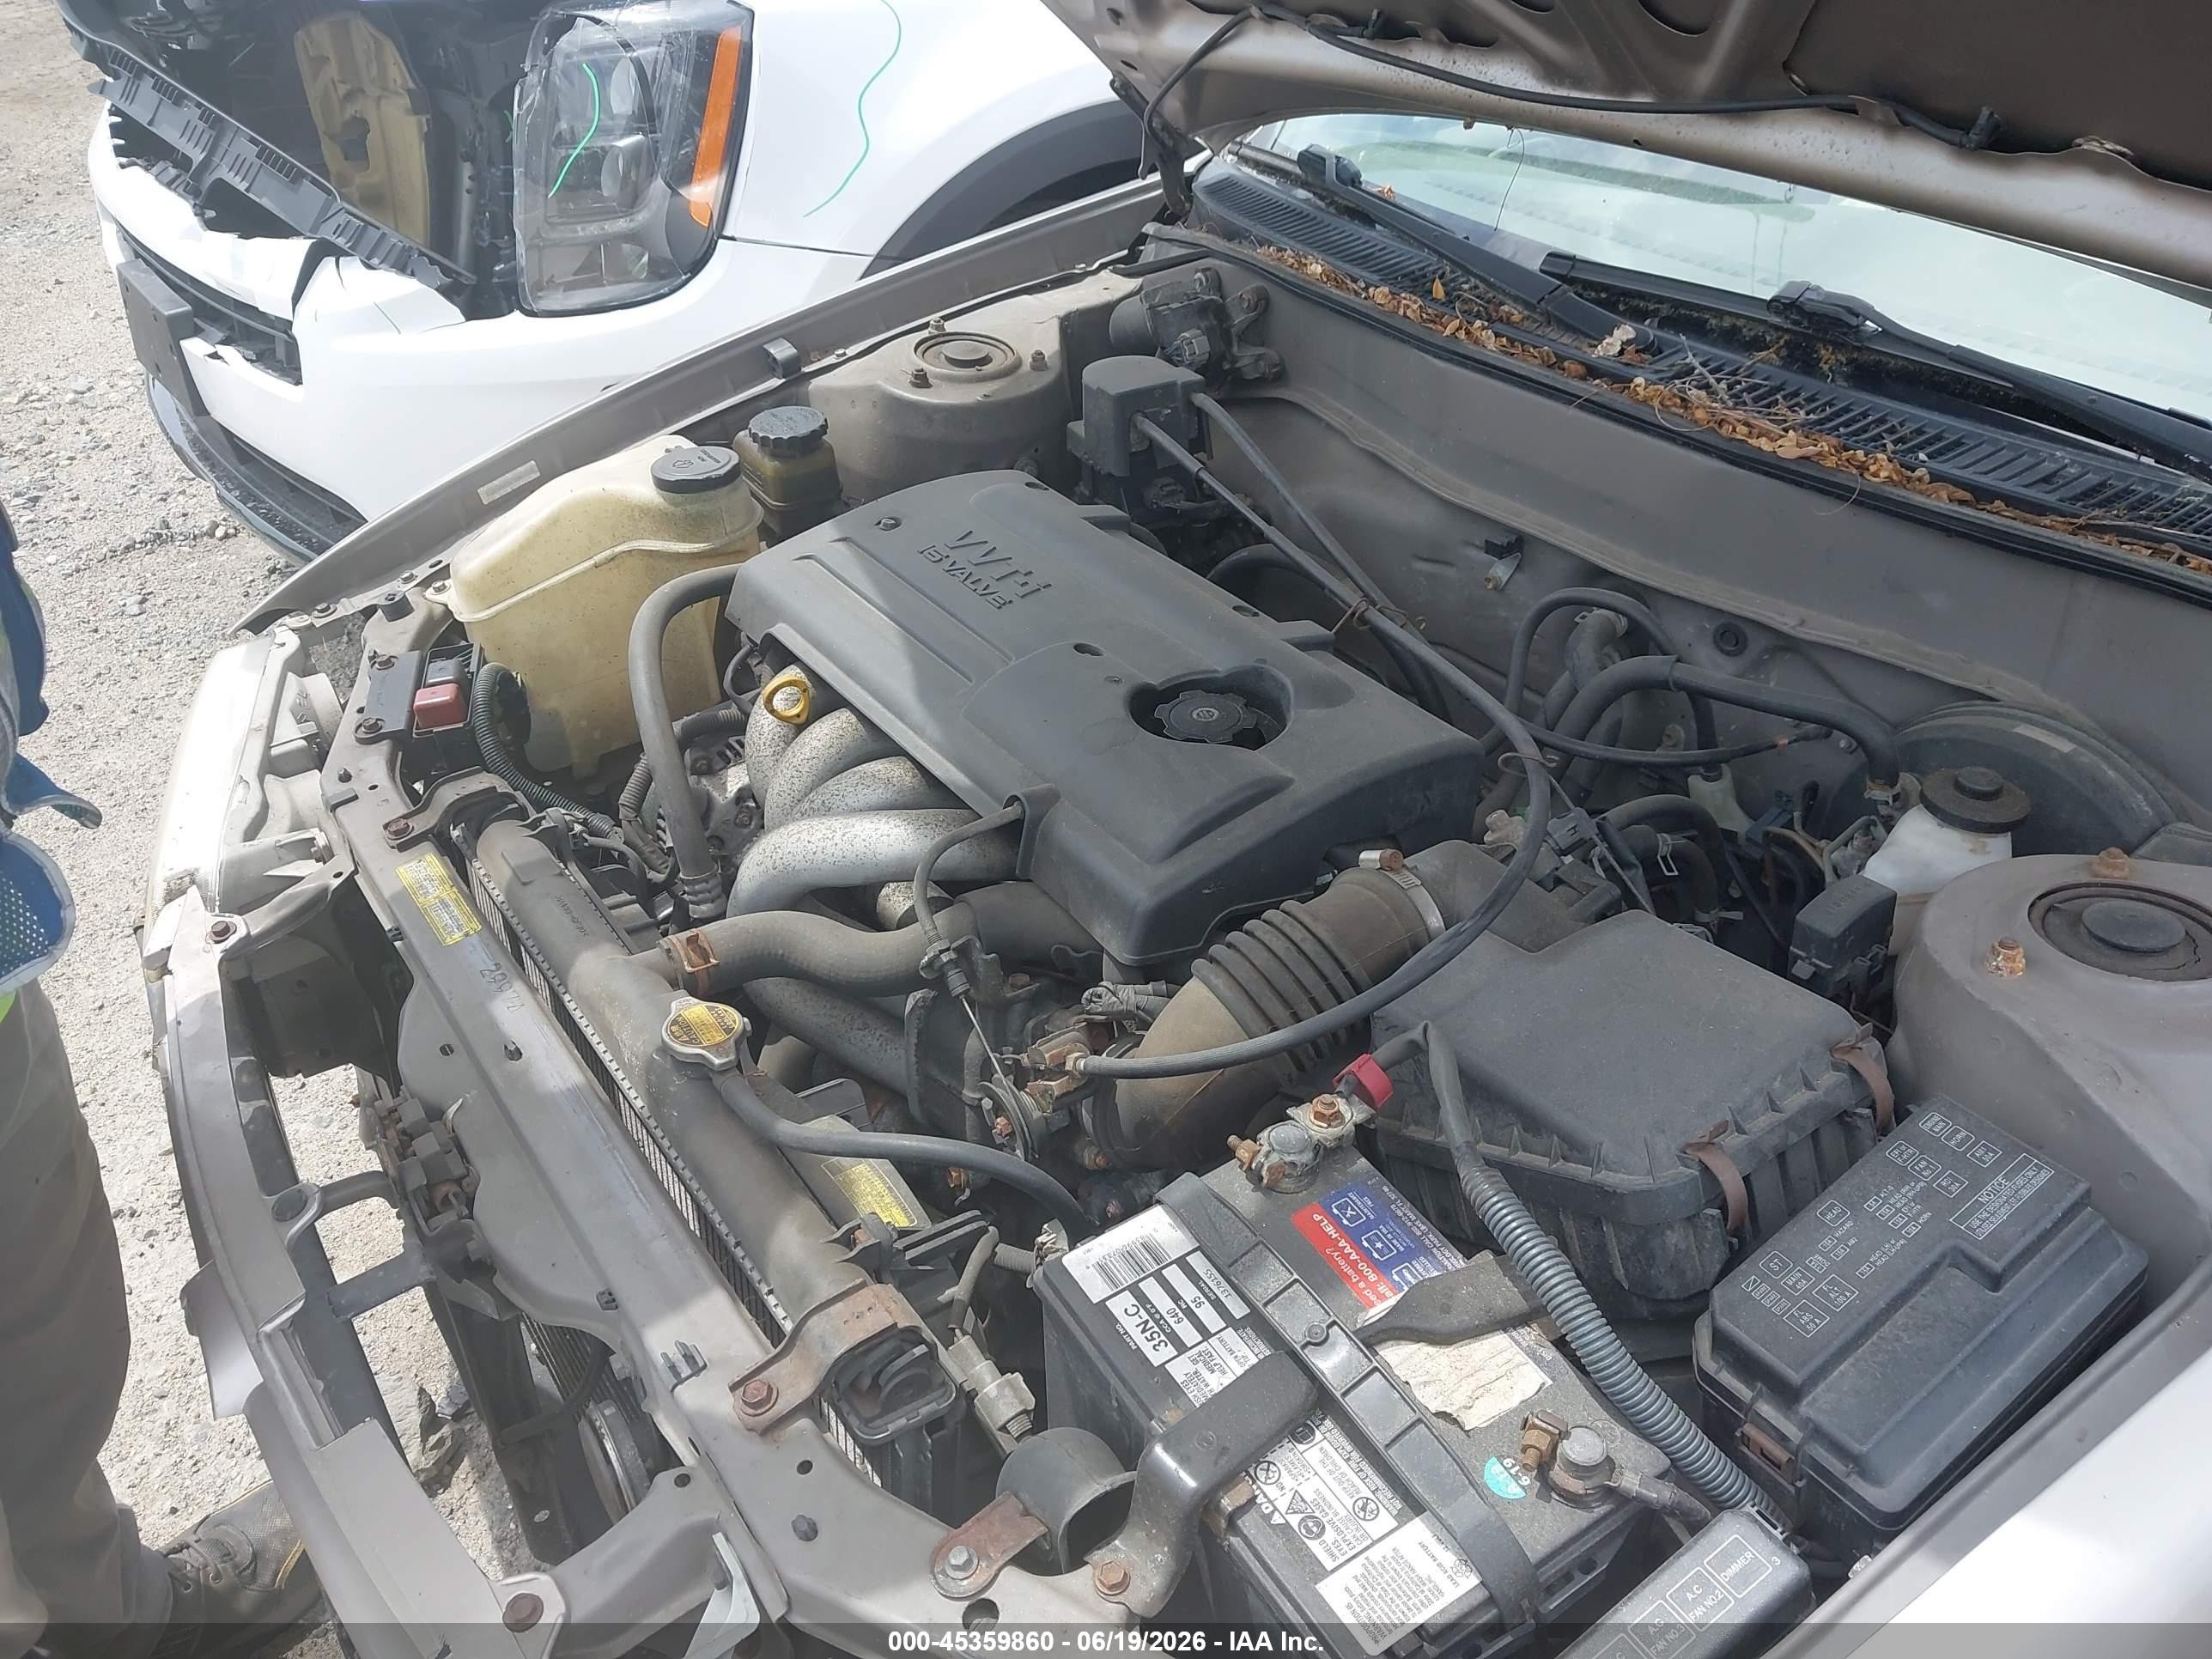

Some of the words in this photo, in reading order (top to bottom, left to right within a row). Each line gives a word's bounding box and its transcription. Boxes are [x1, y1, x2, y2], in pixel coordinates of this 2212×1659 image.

[942, 560, 1014, 611] VALVE
[676, 1016, 700, 1042] CAUTION
[1949, 1131, 1967, 1145] HORN
[1889, 1148, 1902, 1158] EFI
[1914, 1160, 1928, 1171] FAN
[1969, 1217, 1983, 1229] USE
[1978, 1210, 1990, 1221] THE
[1986, 1188, 2015, 1213] DESIGNATED
[2023, 1165, 2039, 1179] ONLY
[1977, 1176, 2010, 1204] NOTICE
[1347, 1191, 1375, 1219] MAINTENANCE
[1362, 1195, 1374, 1206] FREE
[1824, 1205, 1842, 1220] HEAD
[1917, 1211, 1932, 1224] HORN
[1378, 1224, 1389, 1234] USA
[1413, 1218, 1429, 1232] LAKE
[1832, 1219, 1854, 1237] HAZARD
[1311, 1211, 1379, 1283] 800-AAA-HELP
[1391, 1238, 1405, 1251] MADE
[1418, 1235, 1433, 1249] CALL
[1324, 1245, 1360, 1281] battery?
[1868, 1249, 1883, 1261] HEAD
[1768, 1258, 1784, 1271] ST
[1202, 1267, 1232, 1300] 1376155
[1785, 1271, 1802, 1285] MAIN
[1197, 1279, 1217, 1300] SERIAL
[1375, 1280, 1394, 1298] all:
[1821, 1282, 1833, 1291] FL
[1827, 1286, 1841, 1298] ALT
[1176, 1298, 1188, 1309] RC
[1189, 1294, 1206, 1309] 95
[1362, 1289, 1381, 1306] eed
[1832, 1294, 1847, 1306] 100
[1164, 1306, 1185, 1325] 640
[1792, 1308, 1804, 1317] FL
[1797, 1311, 1814, 1325] ABS
[1114, 1322, 1126, 1334] NO.
[1121, 1302, 1169, 1352] 35N-C
[1158, 1318, 1172, 1333] CCA
[1121, 1333, 1137, 1349] PART
[1215, 1334, 1236, 1356] BATTERY.
[1187, 1353, 1200, 1365] GET
[1194, 1349, 1216, 1375] MEDICAL
[1200, 1346, 1216, 1362] FAST.
[1232, 1353, 1246, 1368] OPEN
[1212, 1360, 1228, 1376] HELP
[1183, 1370, 1210, 1401] MEDIATELY
[1191, 1367, 1210, 1389] WATER.
[1179, 1378, 1194, 1395] EYES
[1316, 1423, 1328, 1432] OR
[1324, 1431, 1350, 1459] EXPLOSION
[1328, 1426, 1353, 1453] INVERTED
[1287, 1447, 1310, 1472] SMOKING
[1316, 1443, 1341, 1471] CHILDREN.
[1317, 1456, 1329, 1468] THE
[1348, 1449, 1362, 1463] FOR
[1325, 1465, 1336, 1475] OF
[1338, 1469, 1348, 1479] OF
[1356, 1468, 1367, 1479] OF
[1501, 1455, 1531, 1487] 6-19
[1274, 1480, 1285, 1492] NO
[1332, 1474, 1346, 1486] OUT
[1345, 1476, 1362, 1495] REACH
[1358, 1460, 1394, 1499] RECOMMENDED
[1362, 1475, 1377, 1491] RISK
[1341, 1484, 1356, 1499] KEEP
[1310, 1497, 1329, 1518] GASES
[1312, 1487, 1340, 1517] BLINDNESS
[1372, 1488, 1399, 1516] WARNING:
[1389, 1496, 1403, 1510] NOT
[1335, 1516, 1353, 1534] CAUSE
[1326, 1516, 1356, 1551] EXPLOSIVE
[1349, 1532, 1363, 1546] CAN
[1358, 1531, 1369, 1541] OR
[1317, 1538, 1340, 1562] SHIELD
[1329, 1537, 1348, 1556] EYES.
[1417, 1540, 1438, 1563] BATTERY
[1435, 1561, 1449, 1575] ACID
[1719, 1549, 1755, 1582] DIMMER
[1770, 1555, 1782, 1566] 3
[1446, 1573, 1460, 1588] LEAD
[1684, 1583, 1705, 1601] A.C
[1687, 1604, 1708, 1623] FAN
[1702, 1589, 1725, 1609] NO.2
[1349, 1608, 1381, 1644] PROPOSITION
[1650, 1638, 1669, 1656] FAN
[1664, 1623, 1686, 1644] NO.3
